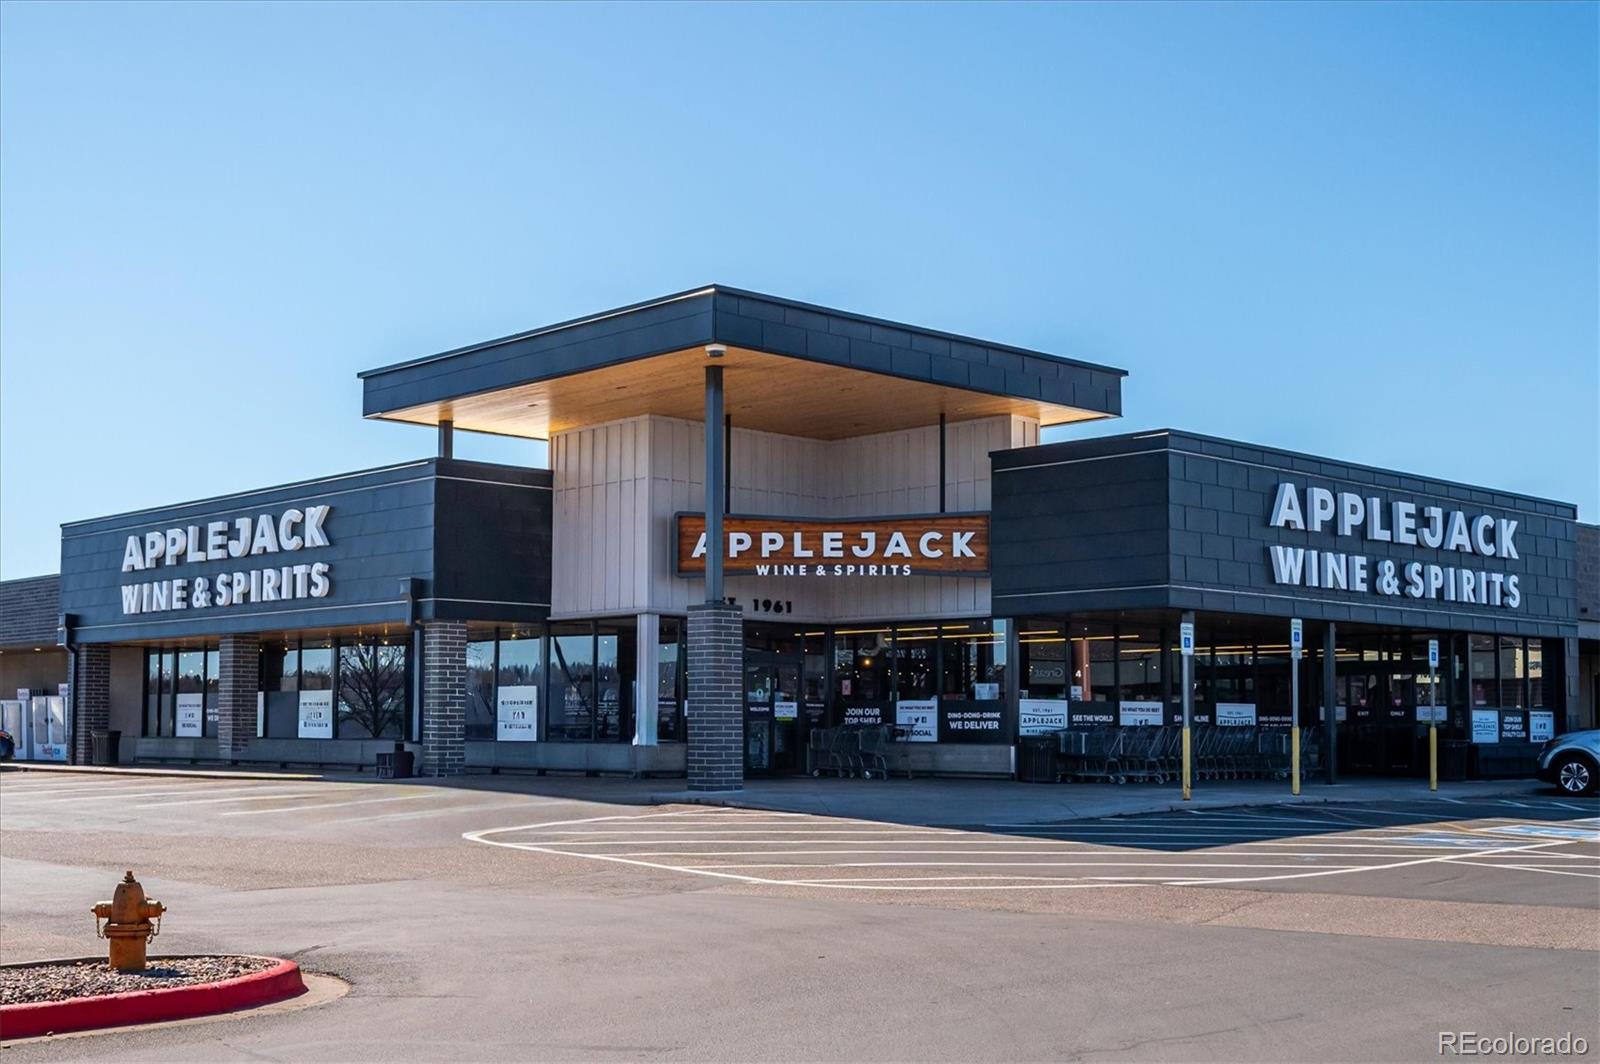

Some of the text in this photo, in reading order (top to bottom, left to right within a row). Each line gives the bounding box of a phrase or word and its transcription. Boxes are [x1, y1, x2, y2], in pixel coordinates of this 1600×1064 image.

[1270, 483, 1519, 559] APPLEJACK
[121, 505, 331, 572] APPLEJACK
[691, 532, 976, 558] APPLEJACK
[755, 564, 912, 576] WINE & SPIRITS
[1270, 545, 1520, 608] WINE & SPIRITS
[121, 562, 330, 615] WINE & SPIRITS
[752, 598, 792, 614] 1961
[1075, 669, 1082, 678] 4
[845, 707, 880, 717] JOIN OUR
[1072, 714, 1113, 722] SEE THE WORLD
[844, 717, 858, 725] TOP
[1194, 715, 1209, 723] NLINE
[949, 721, 999, 730] WE DELIVER
